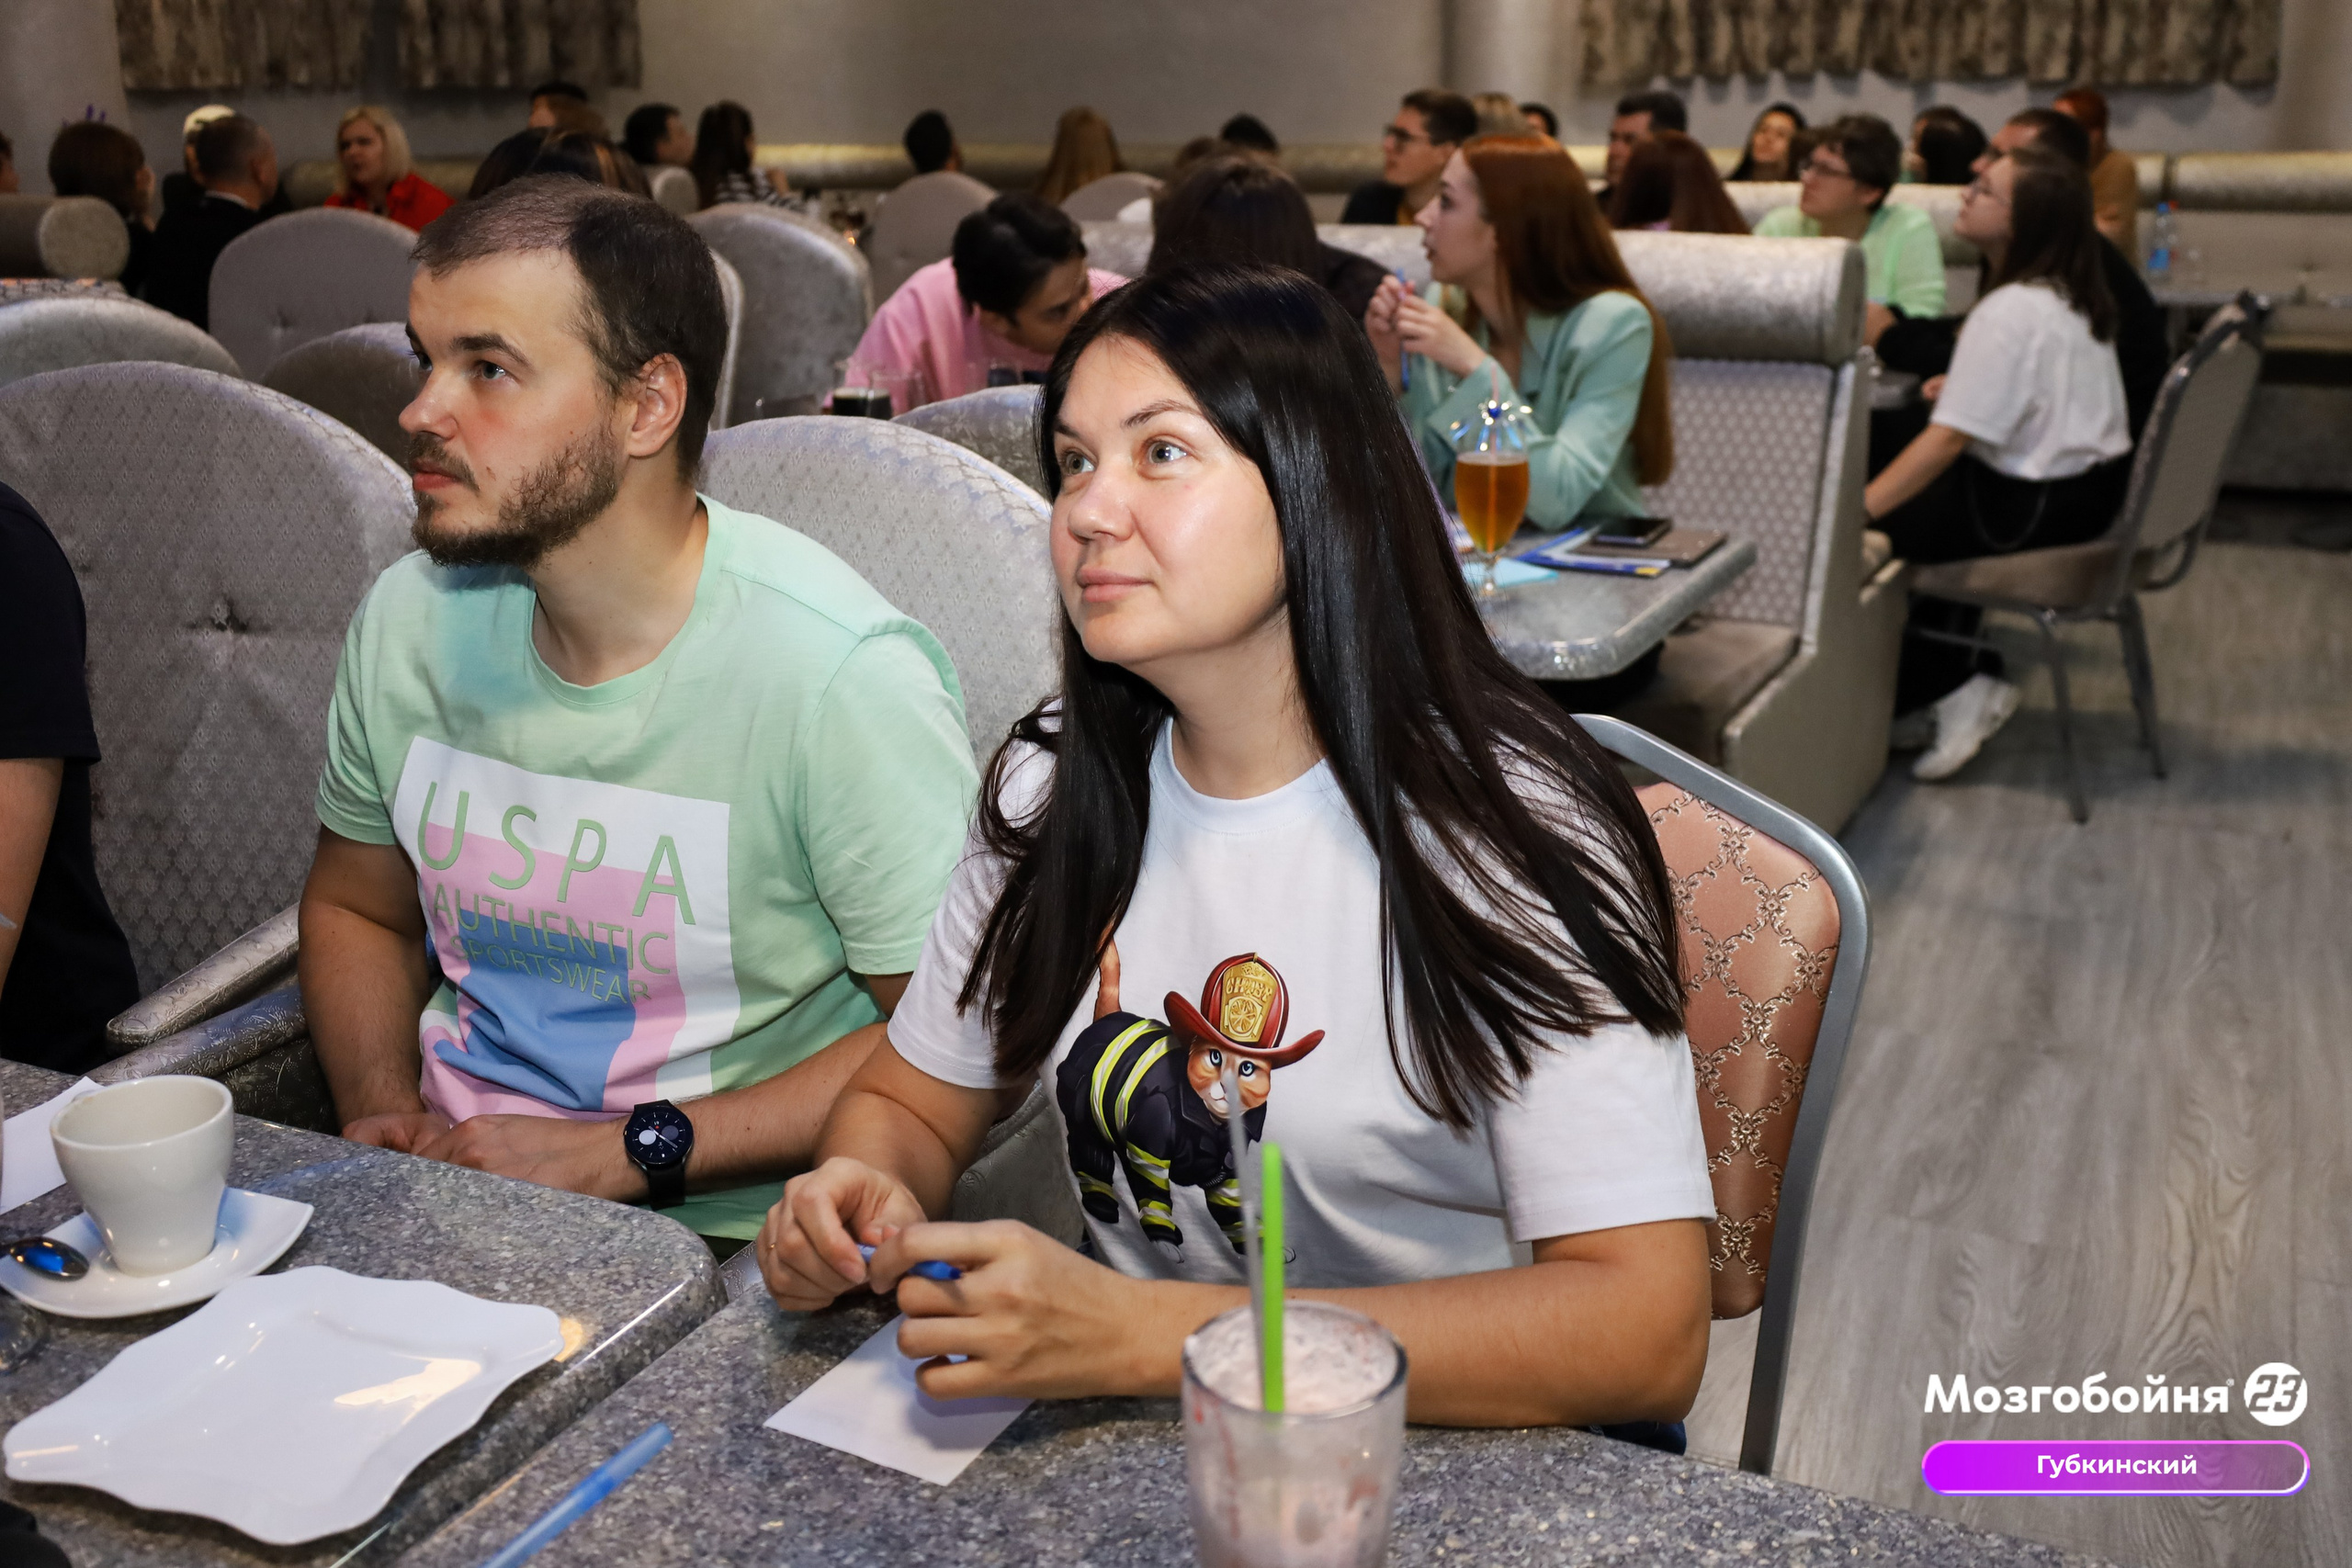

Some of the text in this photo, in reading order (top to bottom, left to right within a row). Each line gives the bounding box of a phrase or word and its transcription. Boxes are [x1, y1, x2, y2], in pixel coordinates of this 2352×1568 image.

[417, 781, 696, 926] USPA
[433, 883, 671, 975] AUTHENTIC
[450, 935, 651, 1003] SPORTSWEAR
